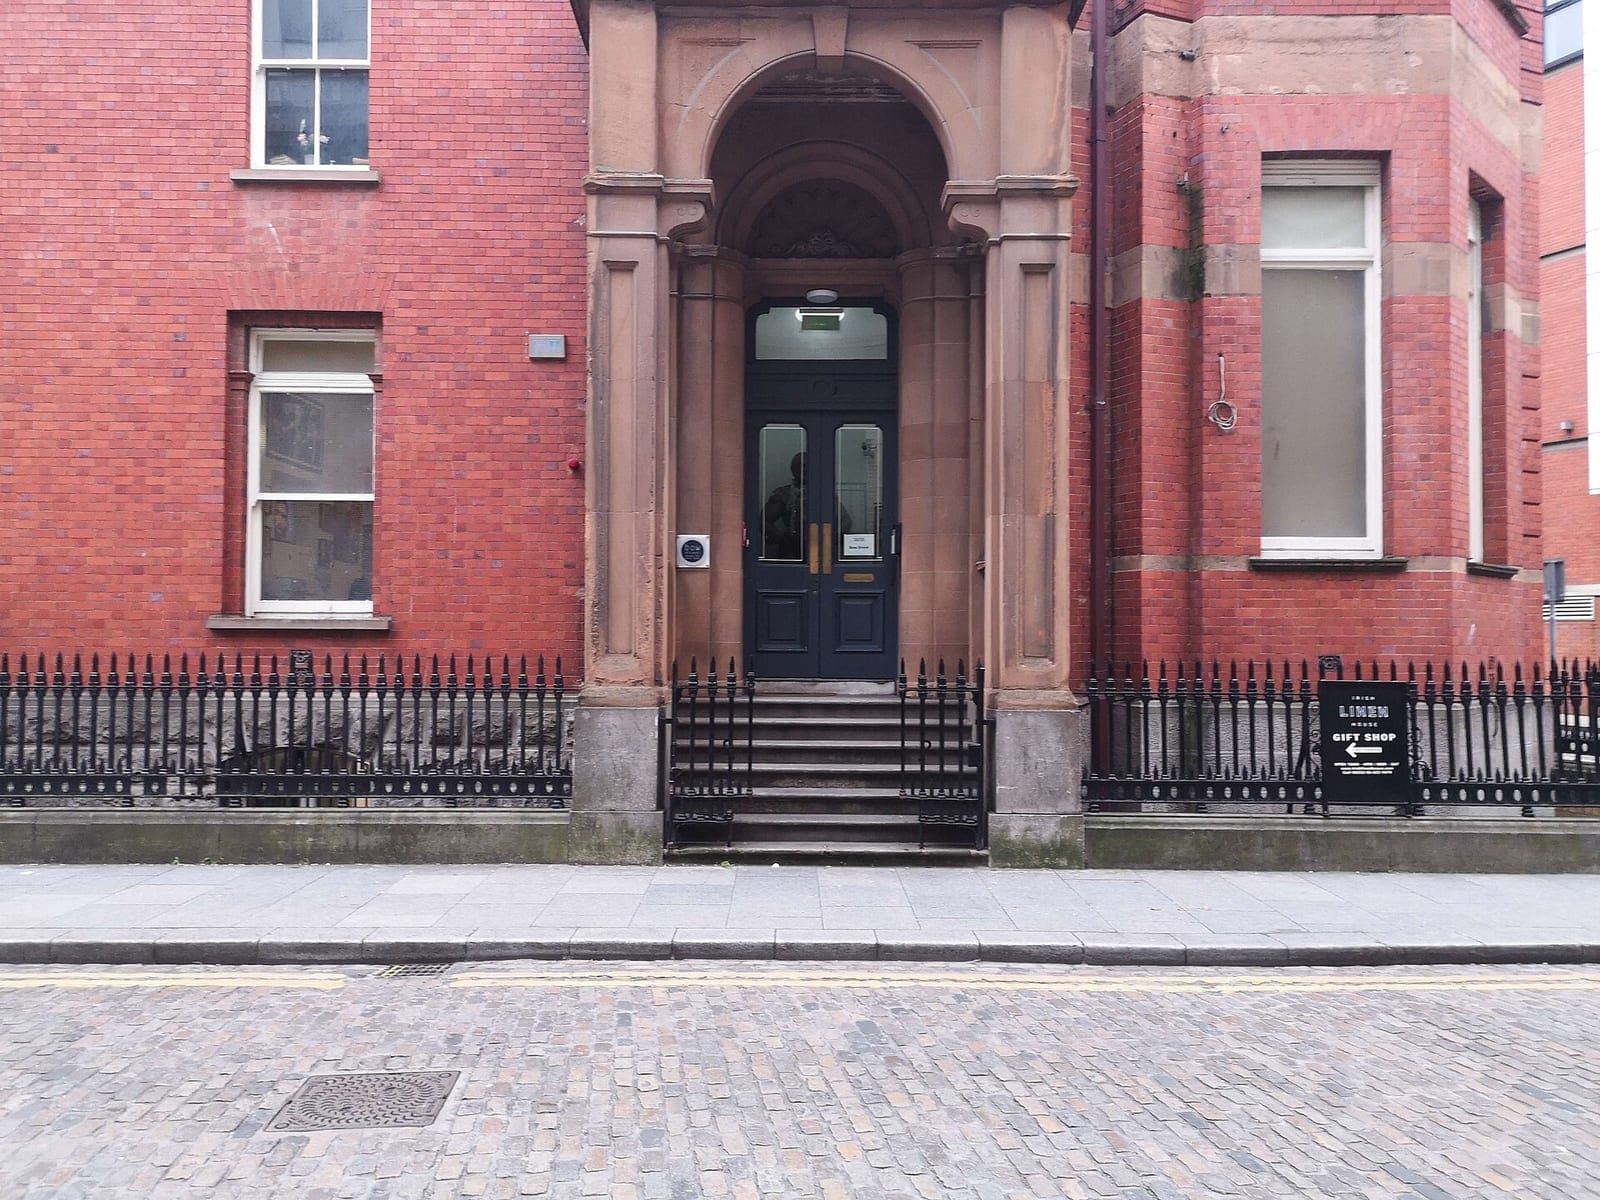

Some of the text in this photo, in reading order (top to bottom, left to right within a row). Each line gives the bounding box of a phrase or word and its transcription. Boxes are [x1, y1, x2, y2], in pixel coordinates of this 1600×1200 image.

[1338, 705, 1390, 718] LINEN
[1332, 732, 1397, 742] GIFT SHOP
